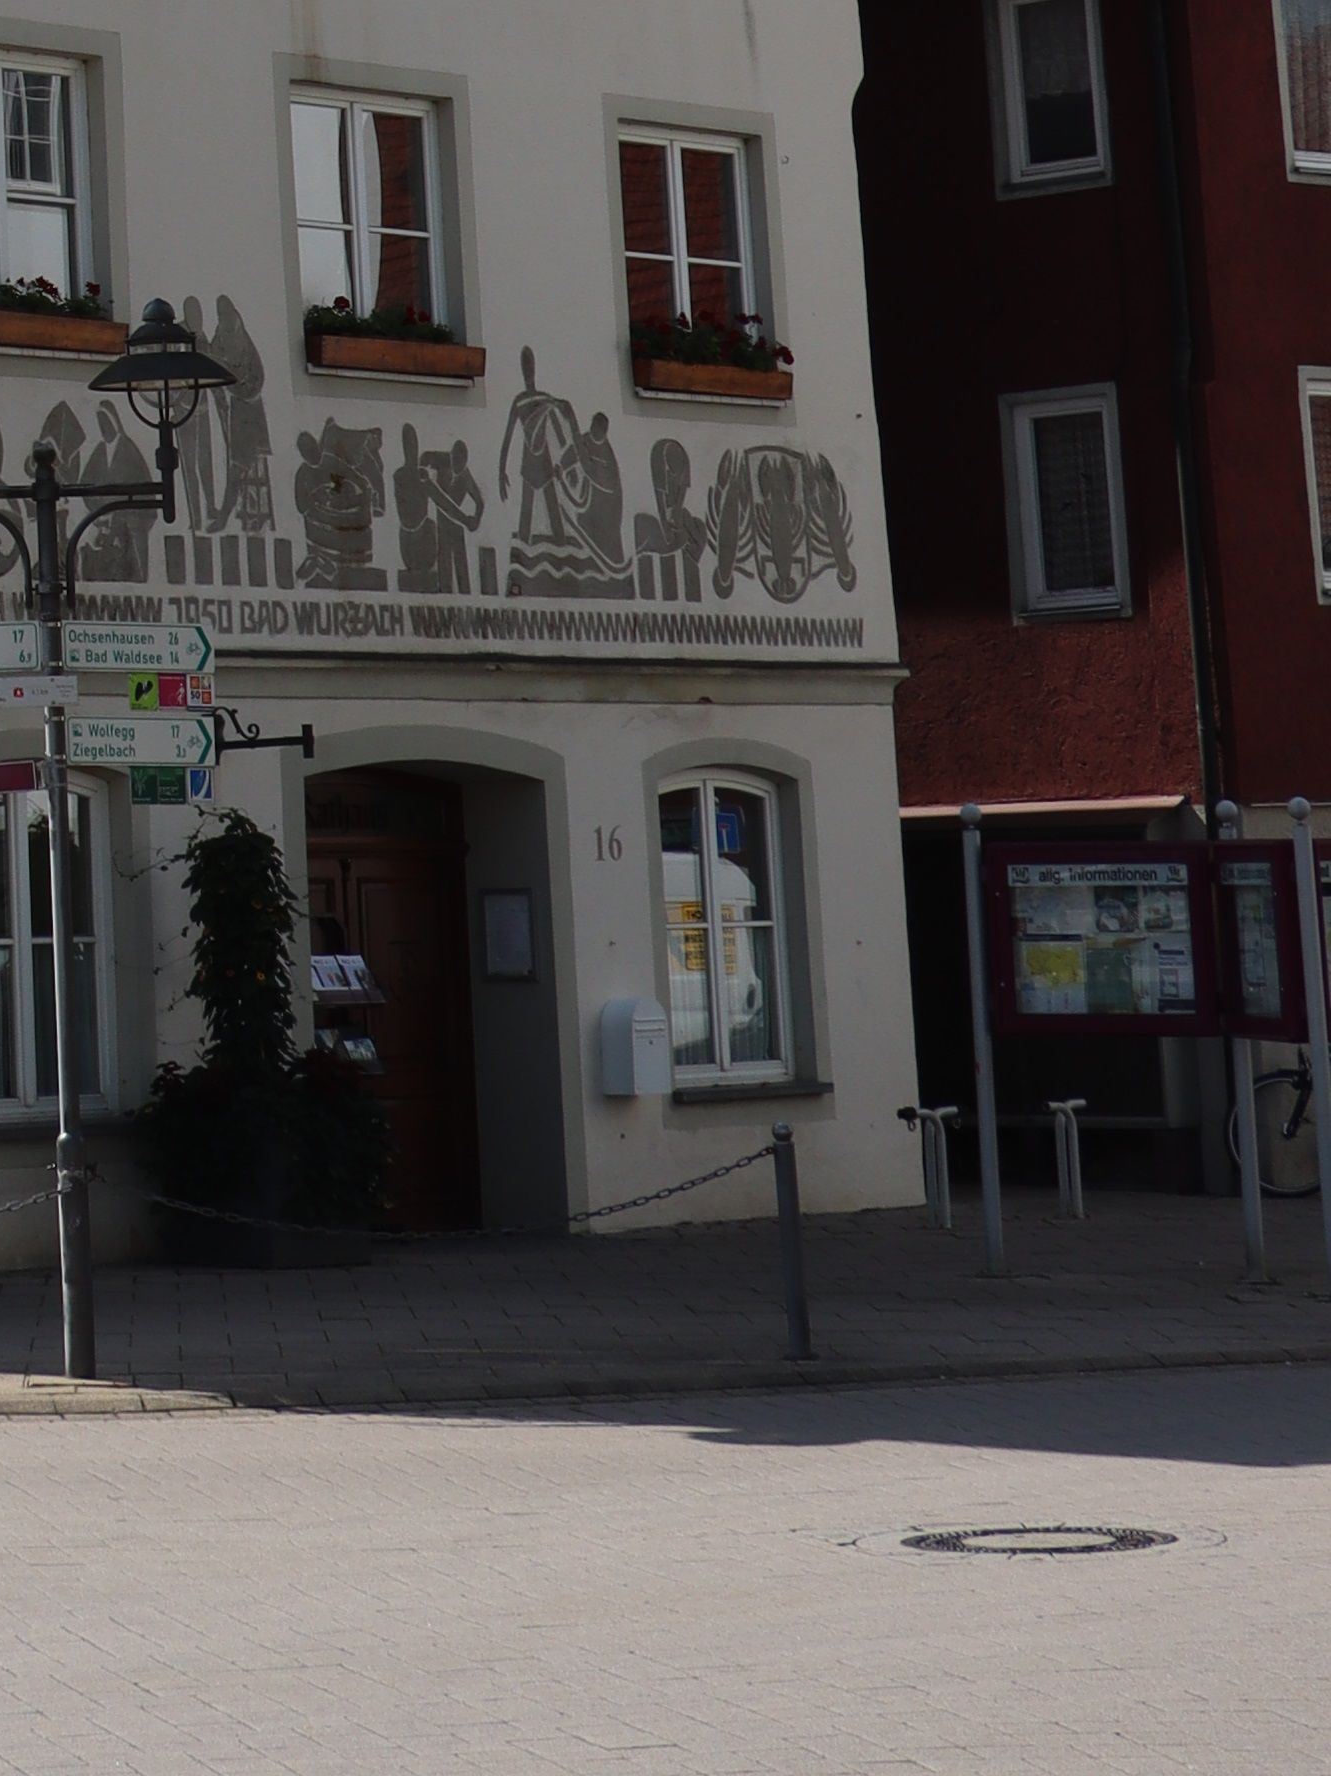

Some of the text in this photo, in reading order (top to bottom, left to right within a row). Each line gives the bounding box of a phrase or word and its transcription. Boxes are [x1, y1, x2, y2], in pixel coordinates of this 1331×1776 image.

[239, 600, 291, 637] BAD
[292, 601, 405, 638] WURZACH
[12, 630, 25, 644] 17
[68, 629, 179, 645] Ochsenhausen 26
[85, 649, 180, 665] Bad Waldsee 14
[88, 723, 180, 741] Wolfegg 17
[73, 743, 136, 760] Ziegelbach
[593, 824, 624, 862] 16
[1038, 867, 1064, 885] allg.
